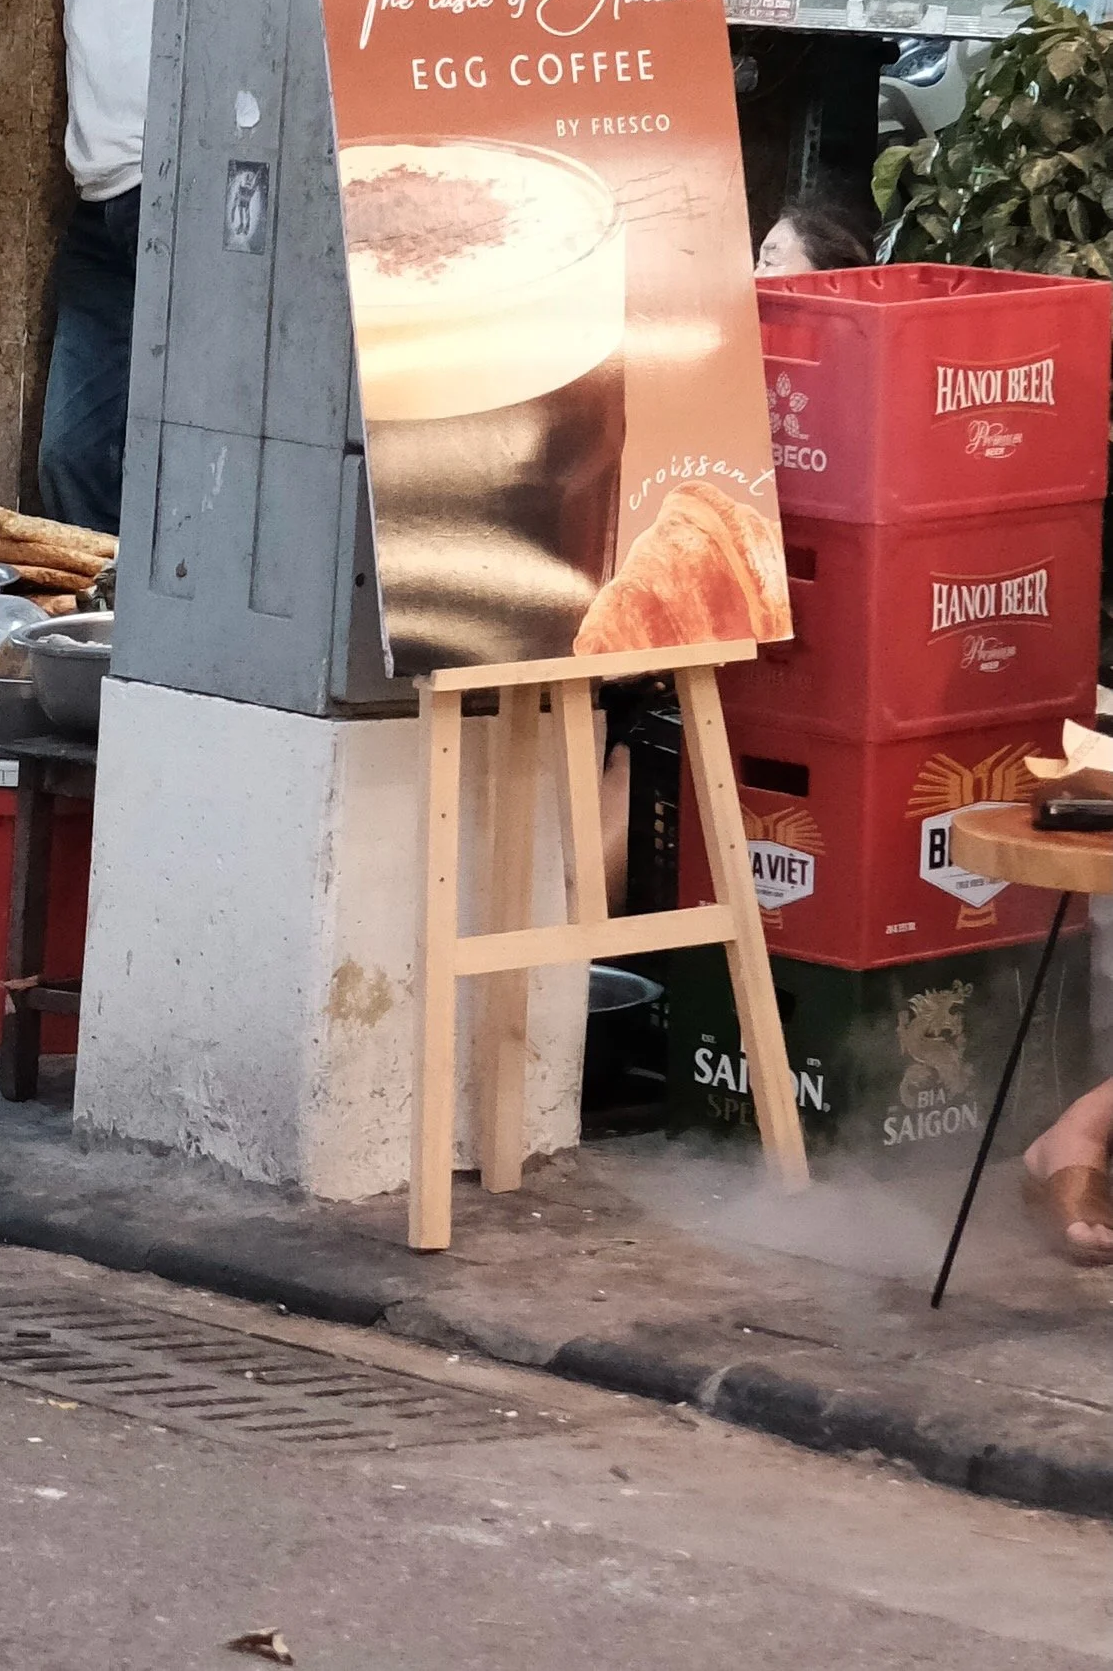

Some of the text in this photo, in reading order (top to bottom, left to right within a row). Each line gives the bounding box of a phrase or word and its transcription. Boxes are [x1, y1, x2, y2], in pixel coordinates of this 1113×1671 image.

[412, 49, 655, 90] EGG COFFEE
[555, 113, 671, 138] BY FRESCO
[934, 358, 1055, 416] HANOI BEER
[629, 455, 775, 512] croissant
[931, 568, 1049, 633] HANOI BEER
[767, 851, 811, 890] VIỆT
[694, 1046, 824, 1111] SAIN
[917, 1088, 947, 1109] BIA
[883, 1100, 978, 1146] SAIGON
